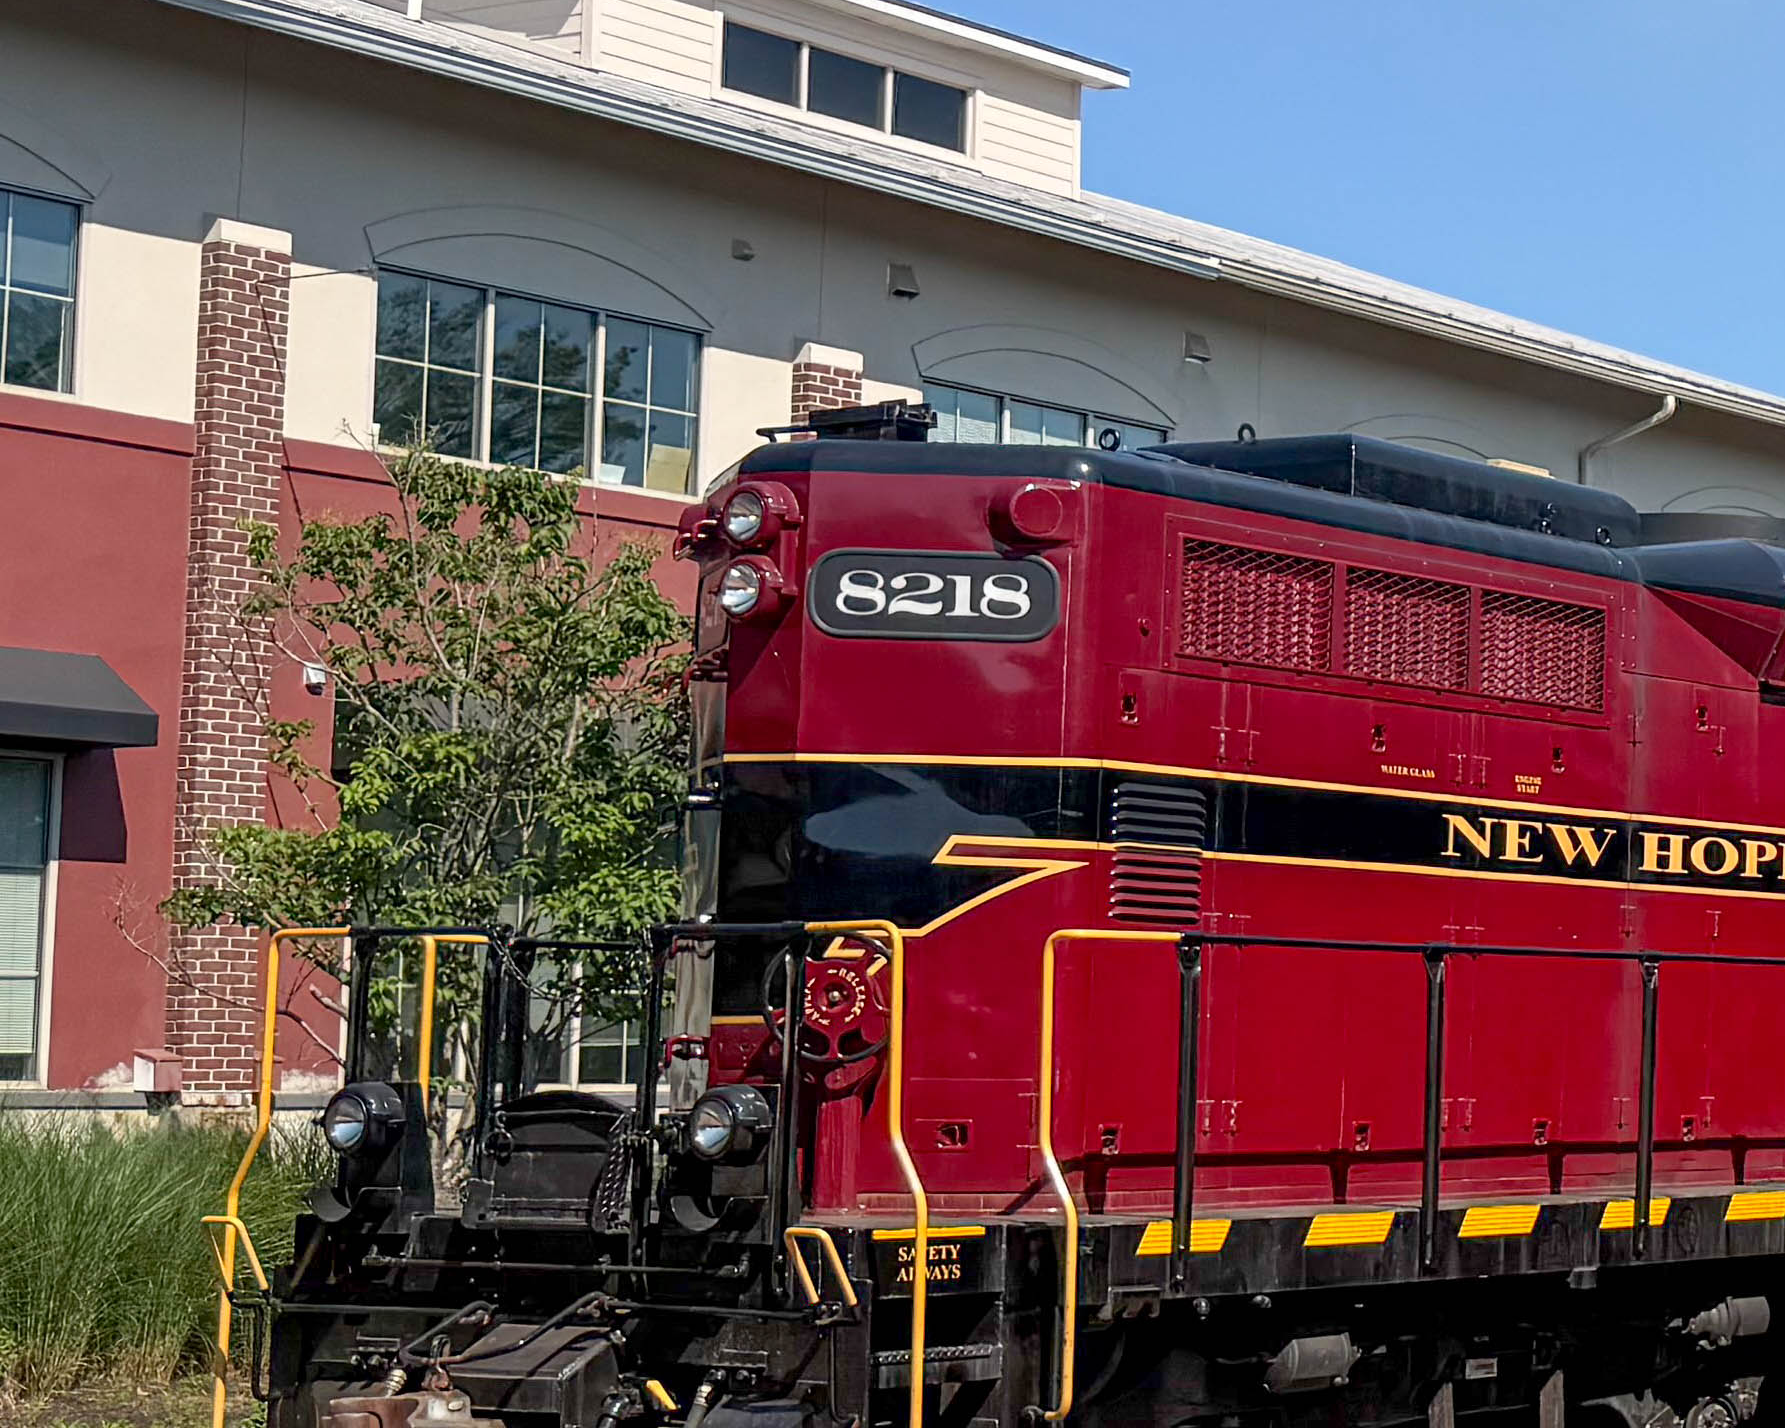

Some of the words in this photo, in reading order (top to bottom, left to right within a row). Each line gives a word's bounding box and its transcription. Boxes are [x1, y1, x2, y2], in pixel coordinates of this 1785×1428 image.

[836, 570, 1031, 619] 8218
[1440, 813, 1617, 867] NEW
[898, 1244, 960, 1262] SAETY
